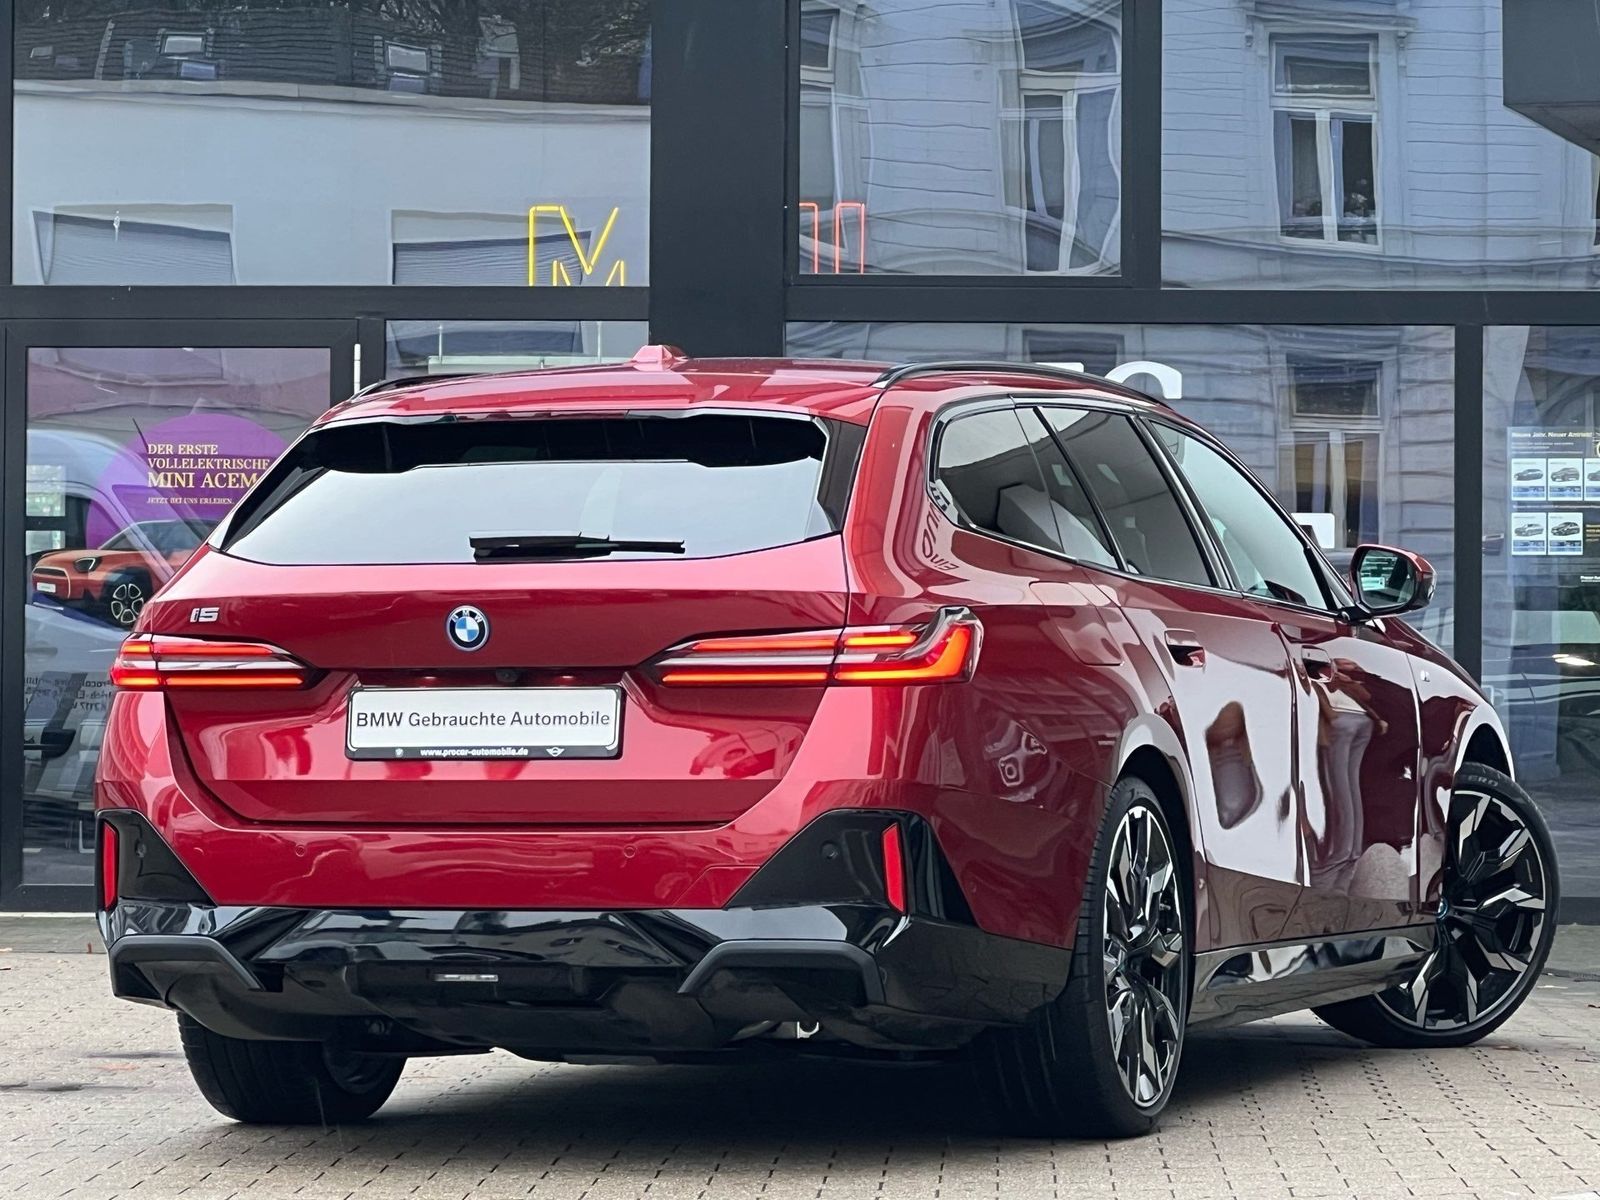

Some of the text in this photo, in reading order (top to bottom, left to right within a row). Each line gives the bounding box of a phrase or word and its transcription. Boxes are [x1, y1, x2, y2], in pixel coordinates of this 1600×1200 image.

[147, 443, 219, 455] DER ERSTE
[147, 472, 195, 489] MINI
[190, 607, 220, 622] i5
[356, 710, 610, 727] BMW Gebrauchte Automobile
[420, 747, 529, 758] www.procar-automobile.de
